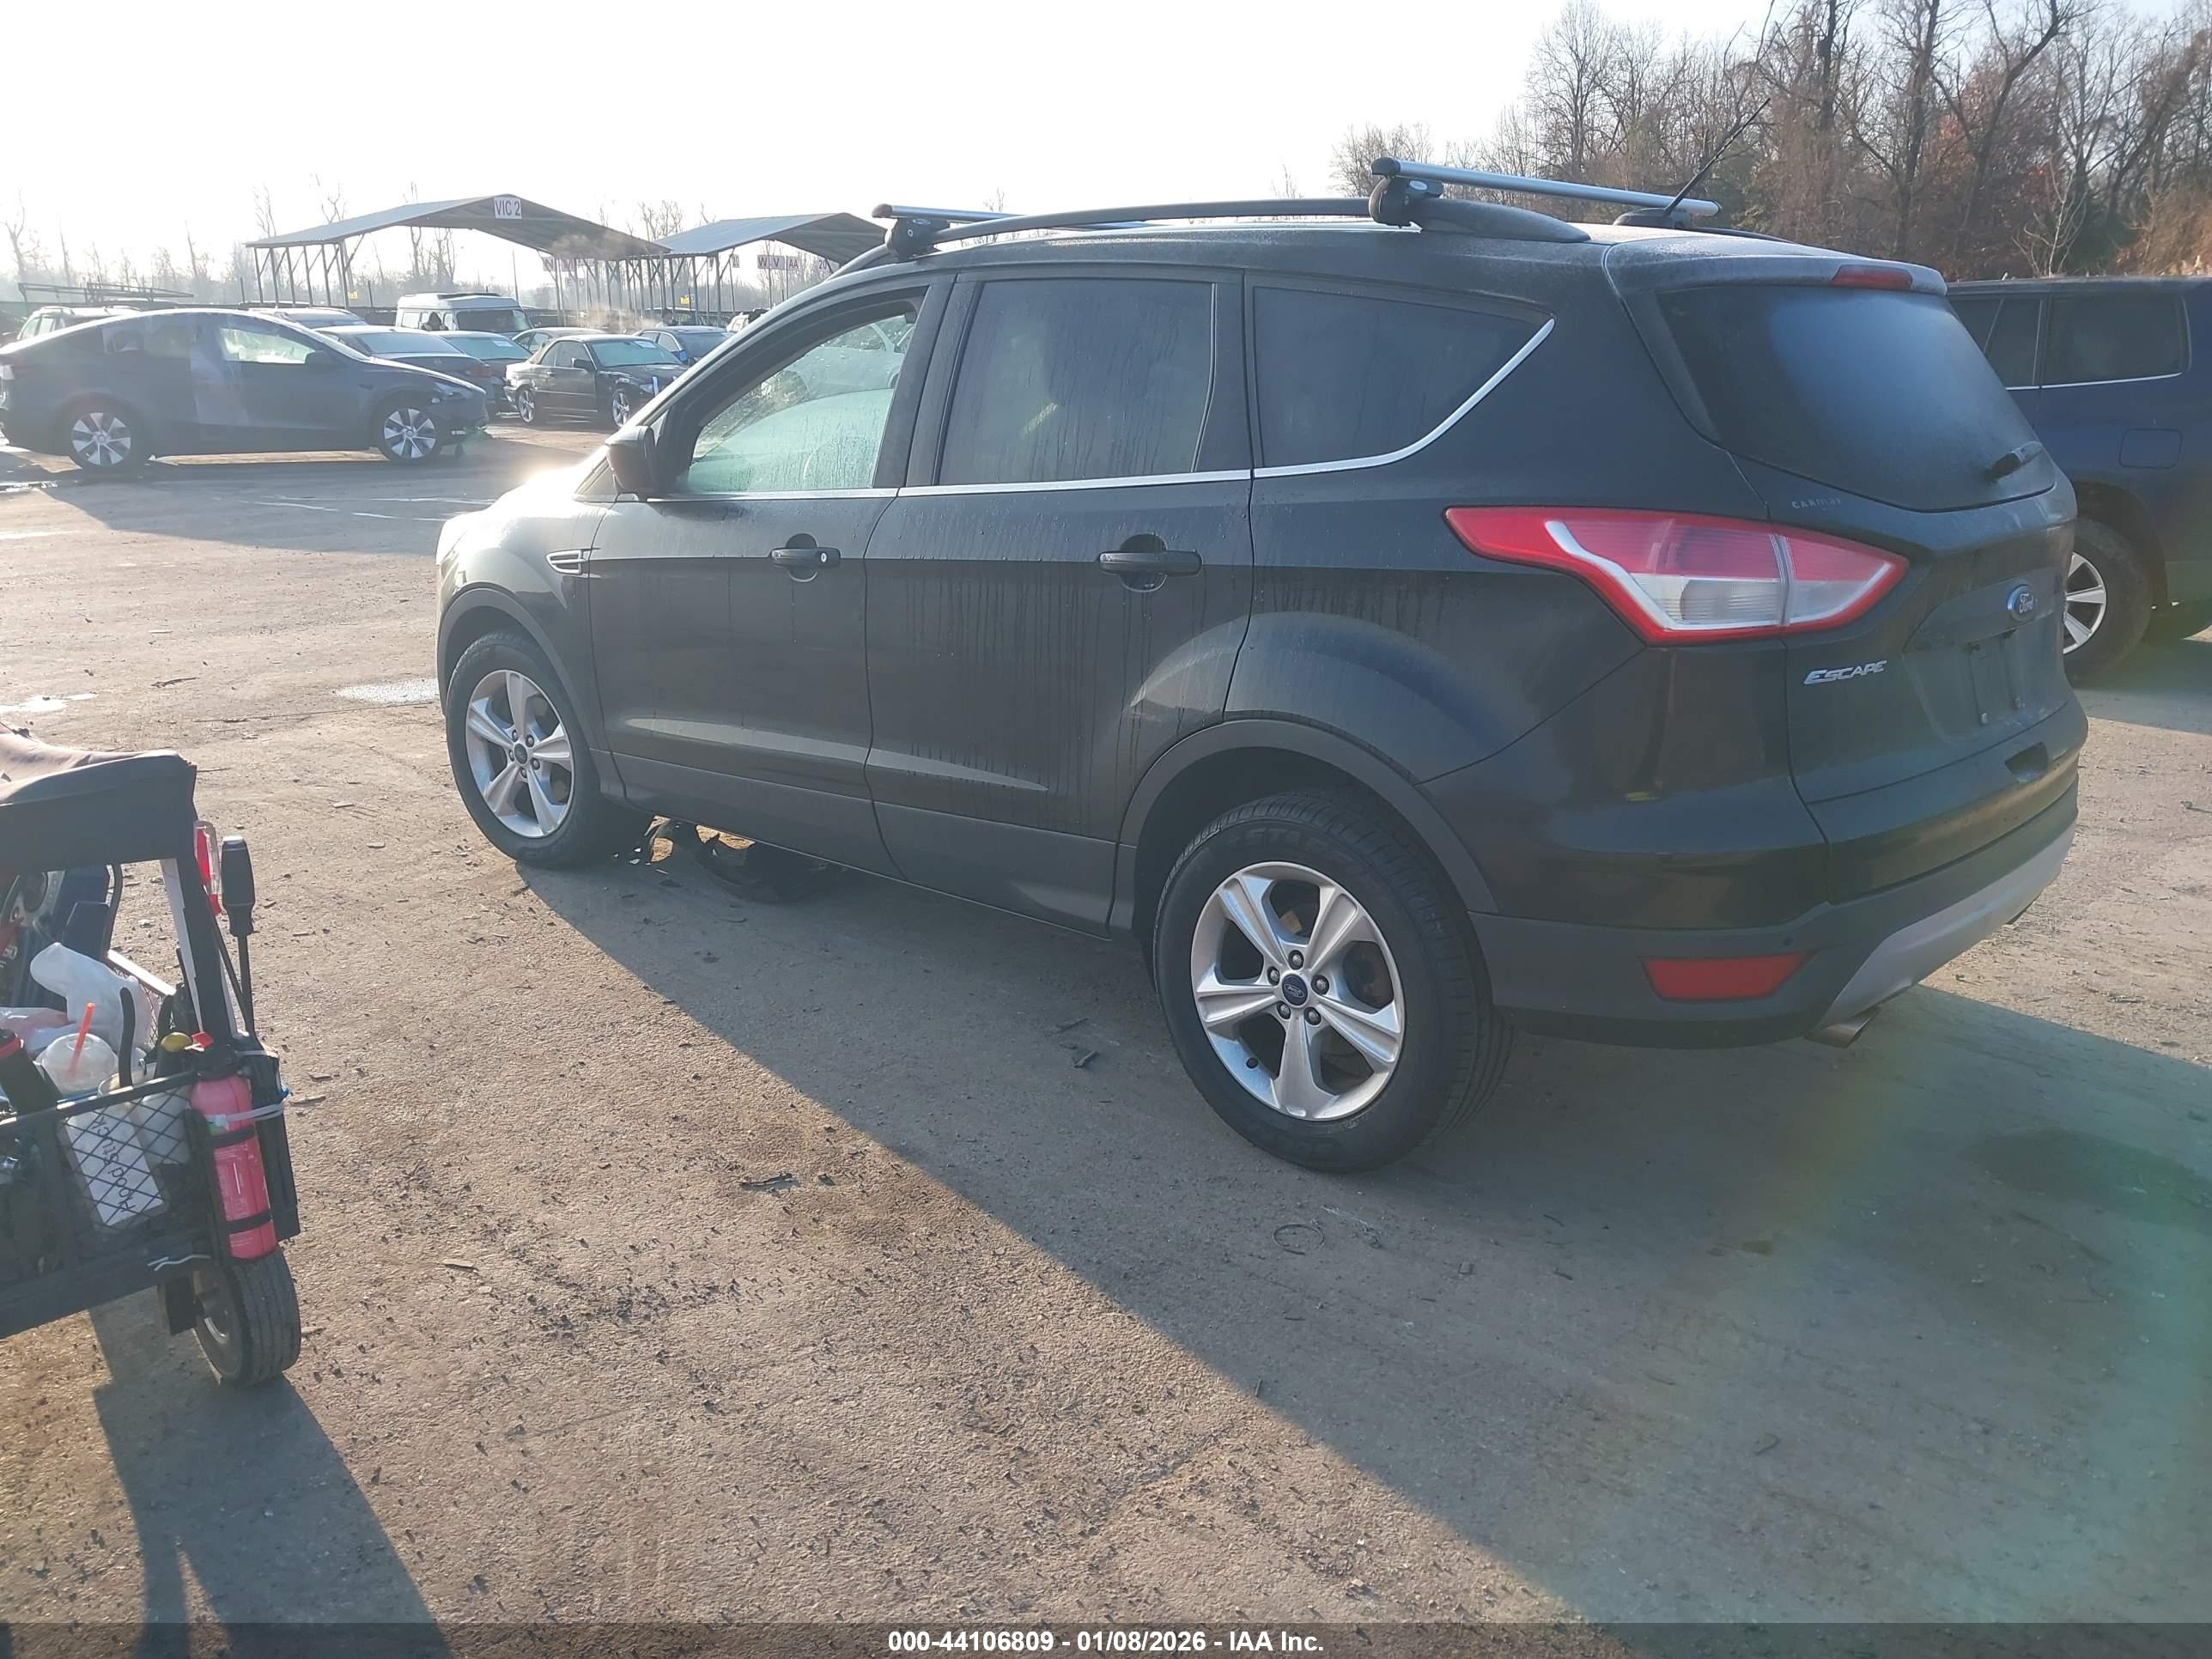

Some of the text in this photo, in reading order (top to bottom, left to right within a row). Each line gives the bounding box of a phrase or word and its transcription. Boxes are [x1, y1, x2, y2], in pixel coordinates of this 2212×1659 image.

[495, 200, 520, 216] VIC 2
[758, 257, 768, 267] W
[773, 257, 780, 267] V
[789, 258, 799, 269] AA
[107, 1167, 137, 1212] Hood
